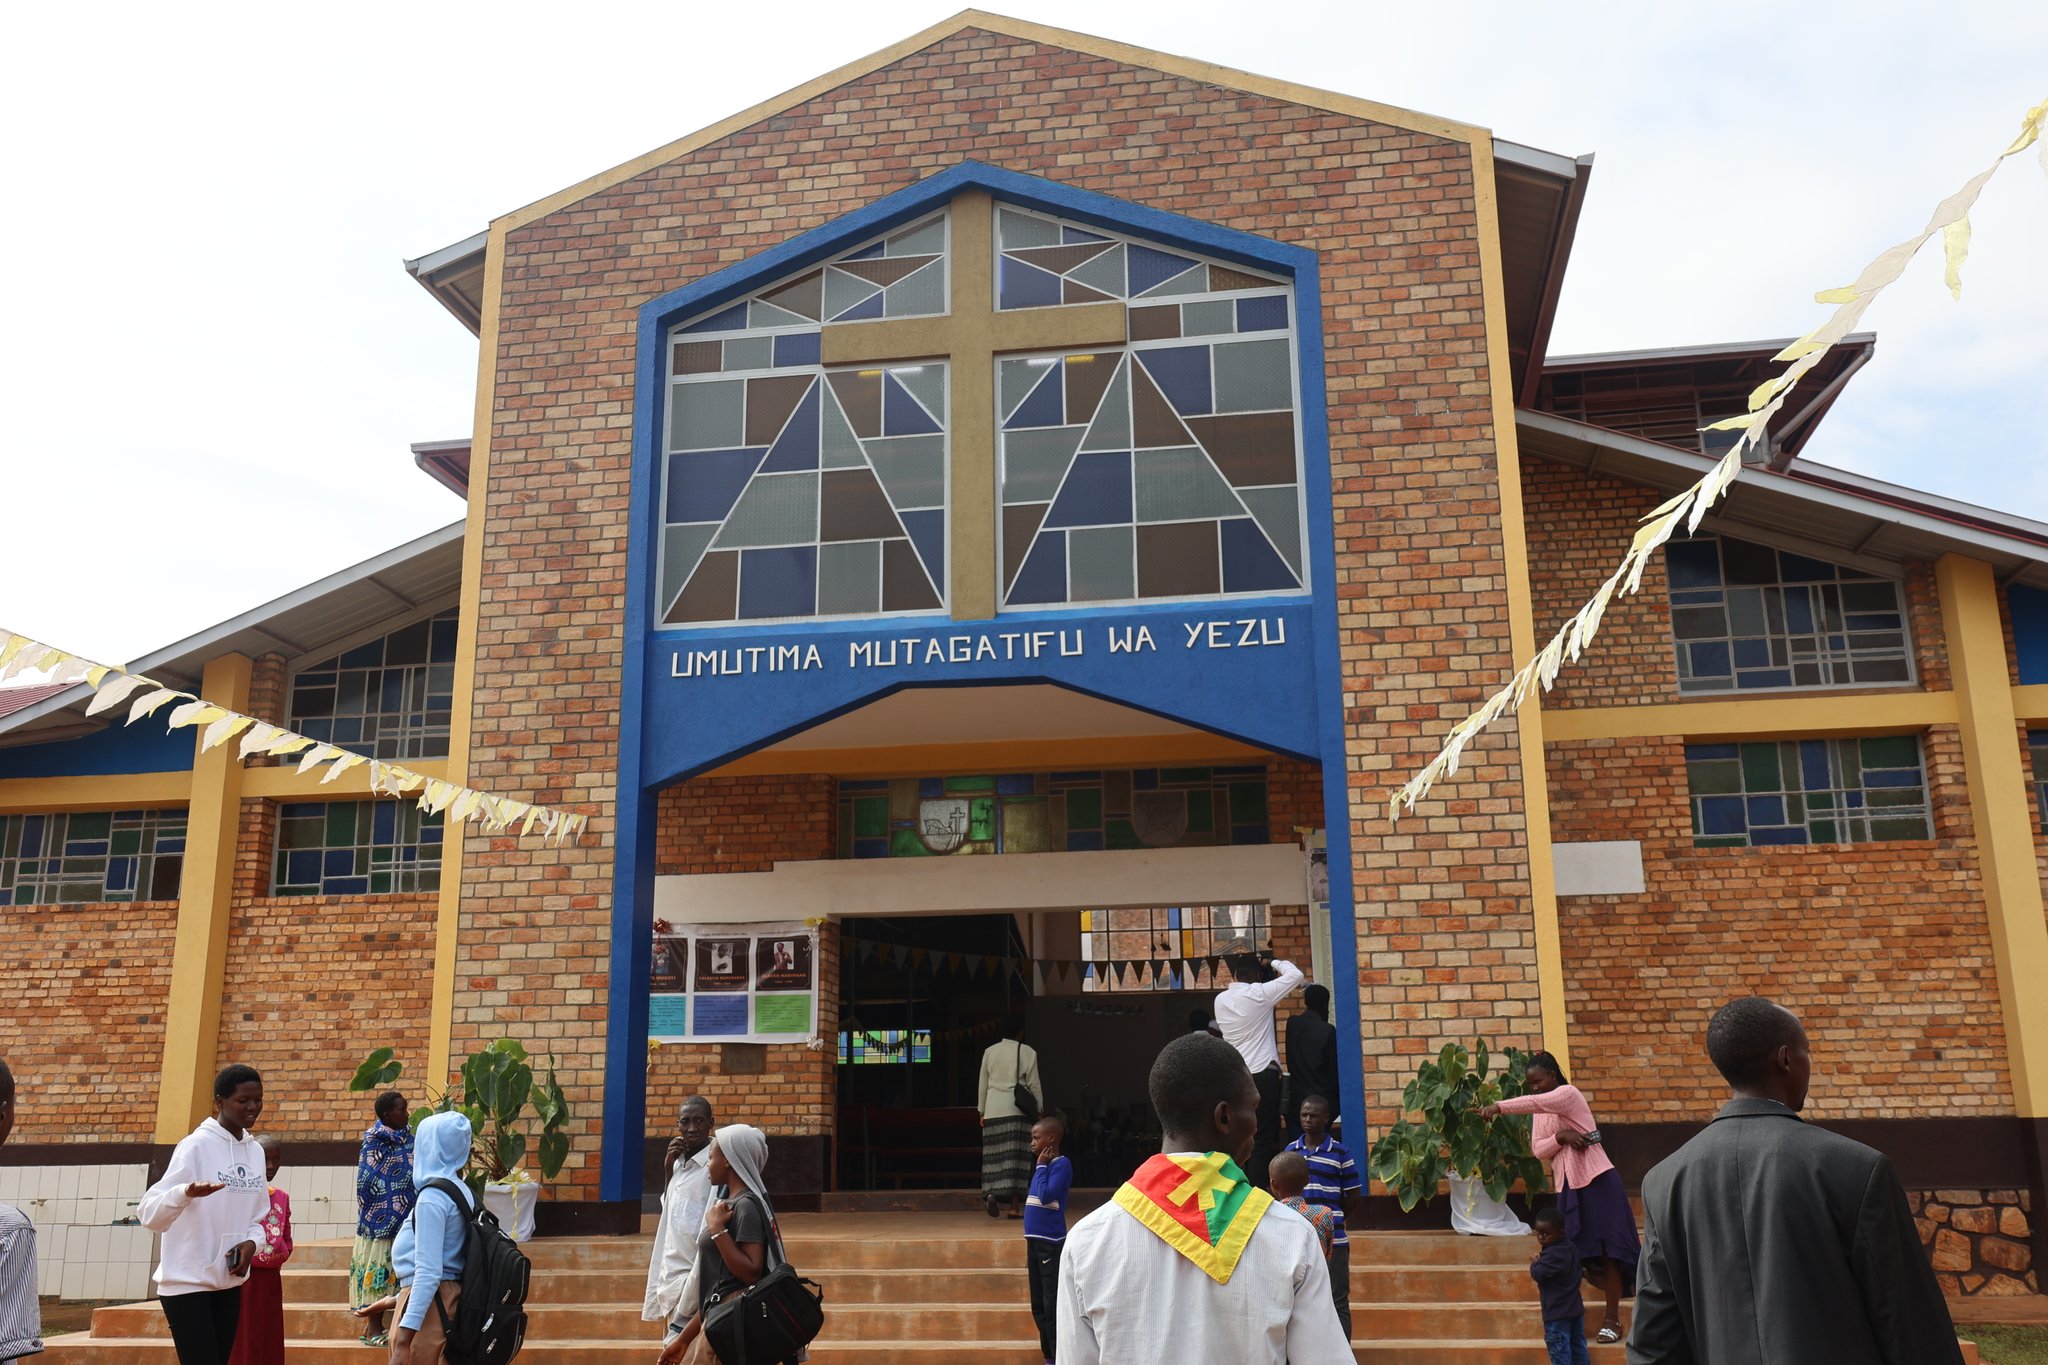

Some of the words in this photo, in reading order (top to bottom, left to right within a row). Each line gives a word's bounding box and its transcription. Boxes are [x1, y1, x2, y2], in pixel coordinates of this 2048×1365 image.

[671, 644, 825, 679] UMUTIMA
[849, 629, 1084, 669] MUTAGATIFU
[1107, 625, 1157, 654] WA
[1184, 617, 1286, 649] YEZU
